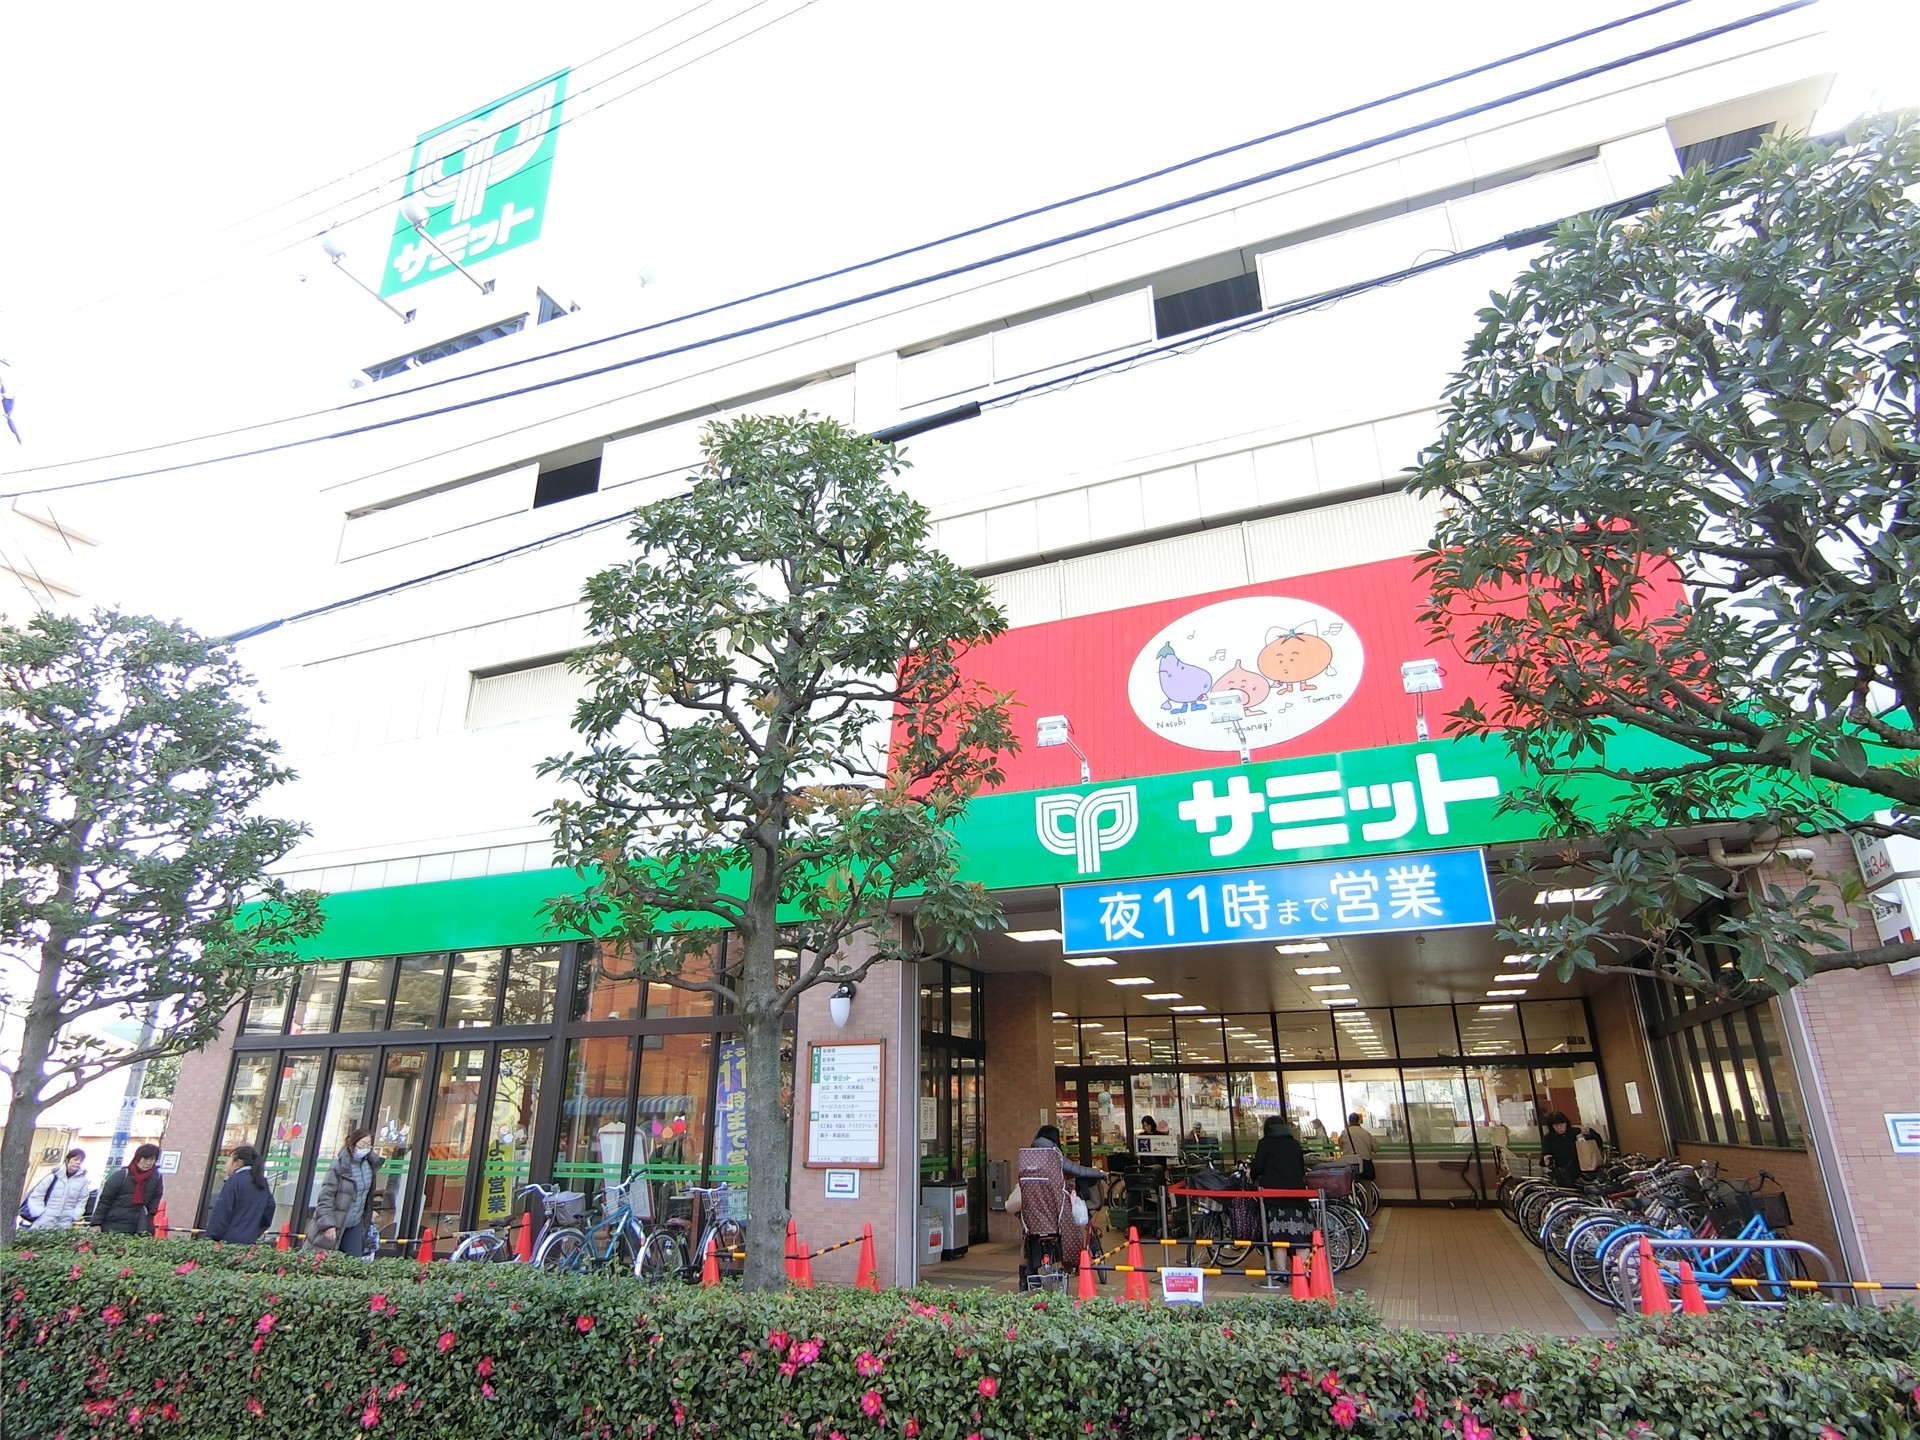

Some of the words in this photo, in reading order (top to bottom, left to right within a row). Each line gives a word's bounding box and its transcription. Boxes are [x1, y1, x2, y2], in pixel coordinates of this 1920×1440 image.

[394, 202, 535, 283] サミット
[1303, 693, 1343, 704] Tomato
[1156, 718, 1187, 729] Nasubi
[1178, 752, 1500, 857] サミット
[1098, 865, 1443, 942] 夜11時まで営業
[722, 1047, 746, 1060] よる
